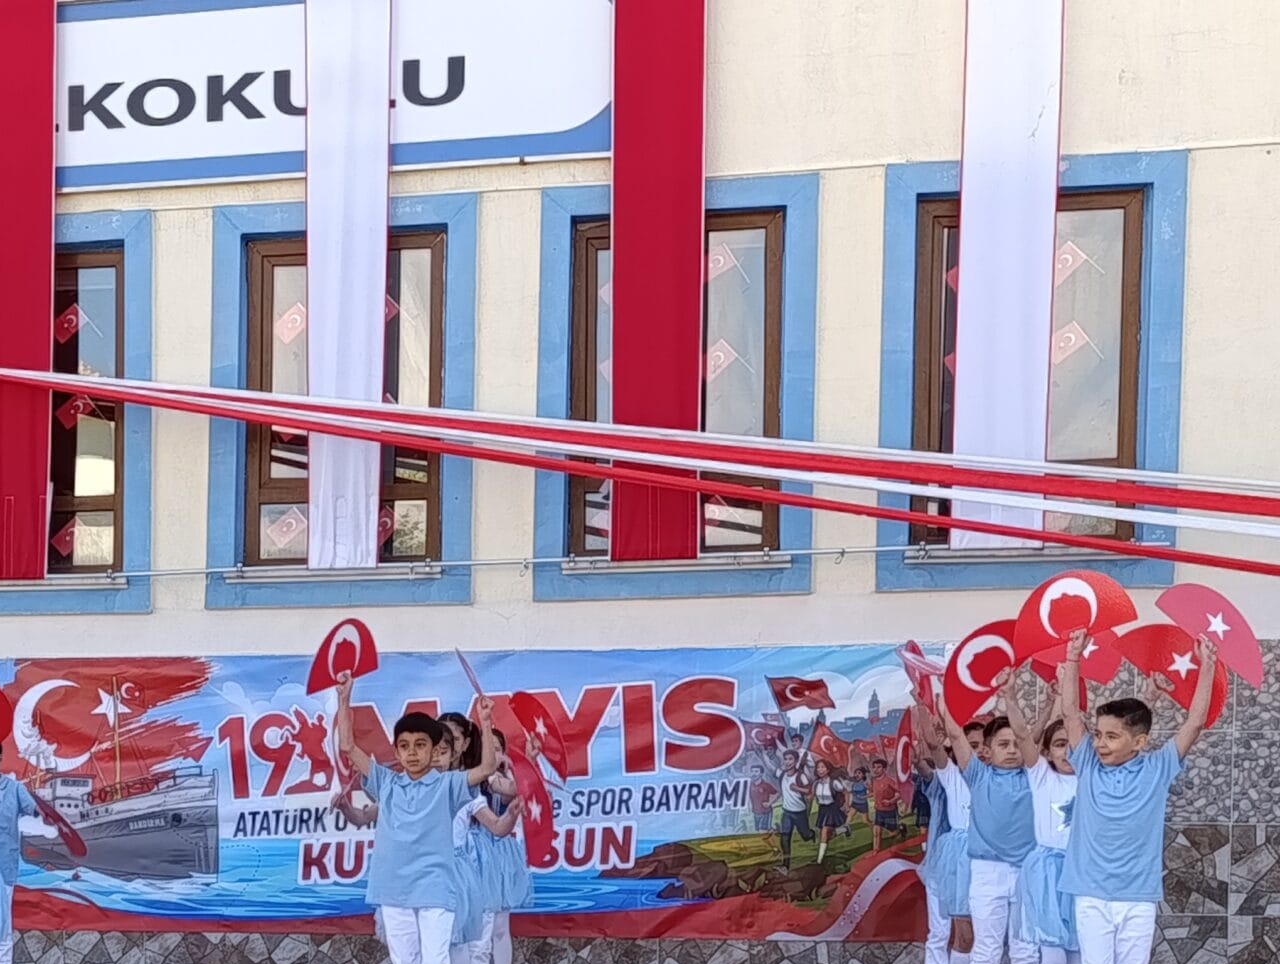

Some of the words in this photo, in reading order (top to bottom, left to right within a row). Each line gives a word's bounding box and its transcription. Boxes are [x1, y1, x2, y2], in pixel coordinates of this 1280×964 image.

[217, 713, 308, 799] 19
[571, 787, 633, 819] SPOR
[640, 780, 750, 813] BAYRAMI
